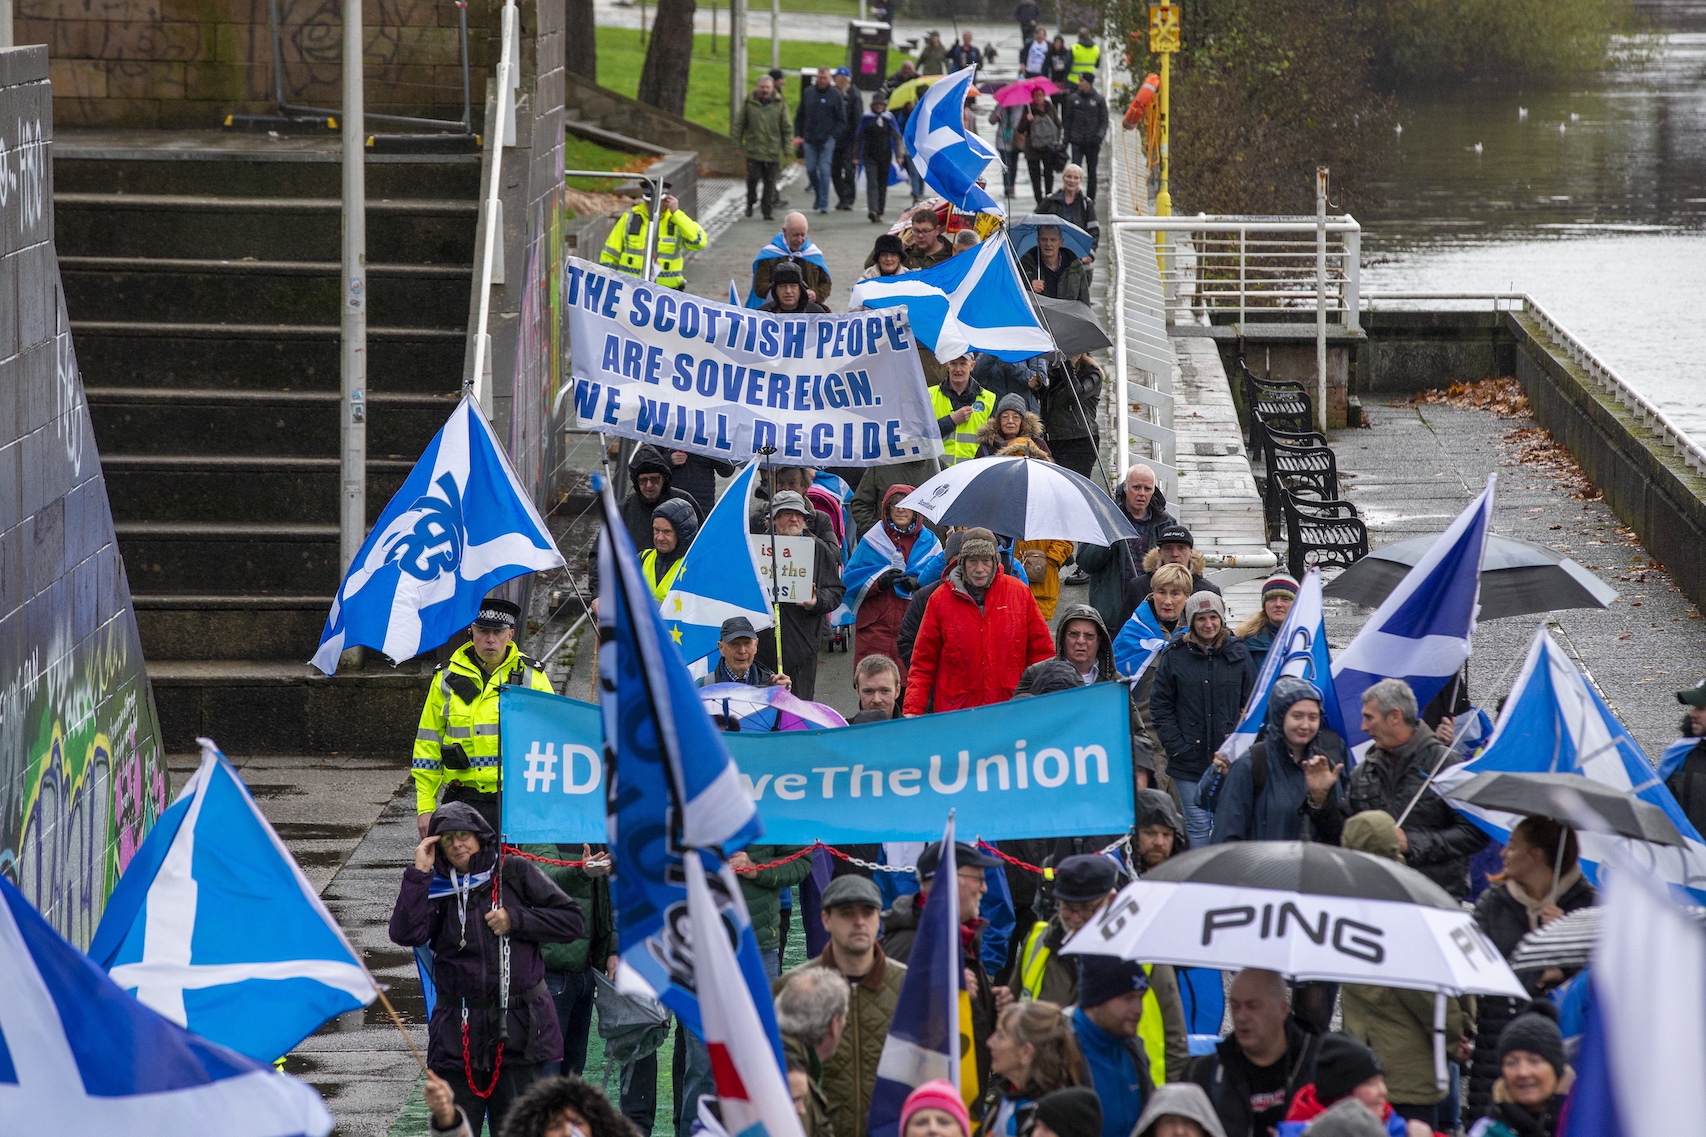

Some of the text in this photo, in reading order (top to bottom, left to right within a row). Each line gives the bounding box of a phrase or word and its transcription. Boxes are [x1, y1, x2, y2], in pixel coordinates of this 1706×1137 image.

[567, 265, 910, 359] THE SCOTTISH PEOPE
[601, 334, 882, 411] ARE SOVEREIGN.
[573, 378, 921, 460] WE WILL DECIDE.
[781, 561, 807, 578] the
[783, 547, 792, 558] a
[1201, 901, 1386, 964] PING
